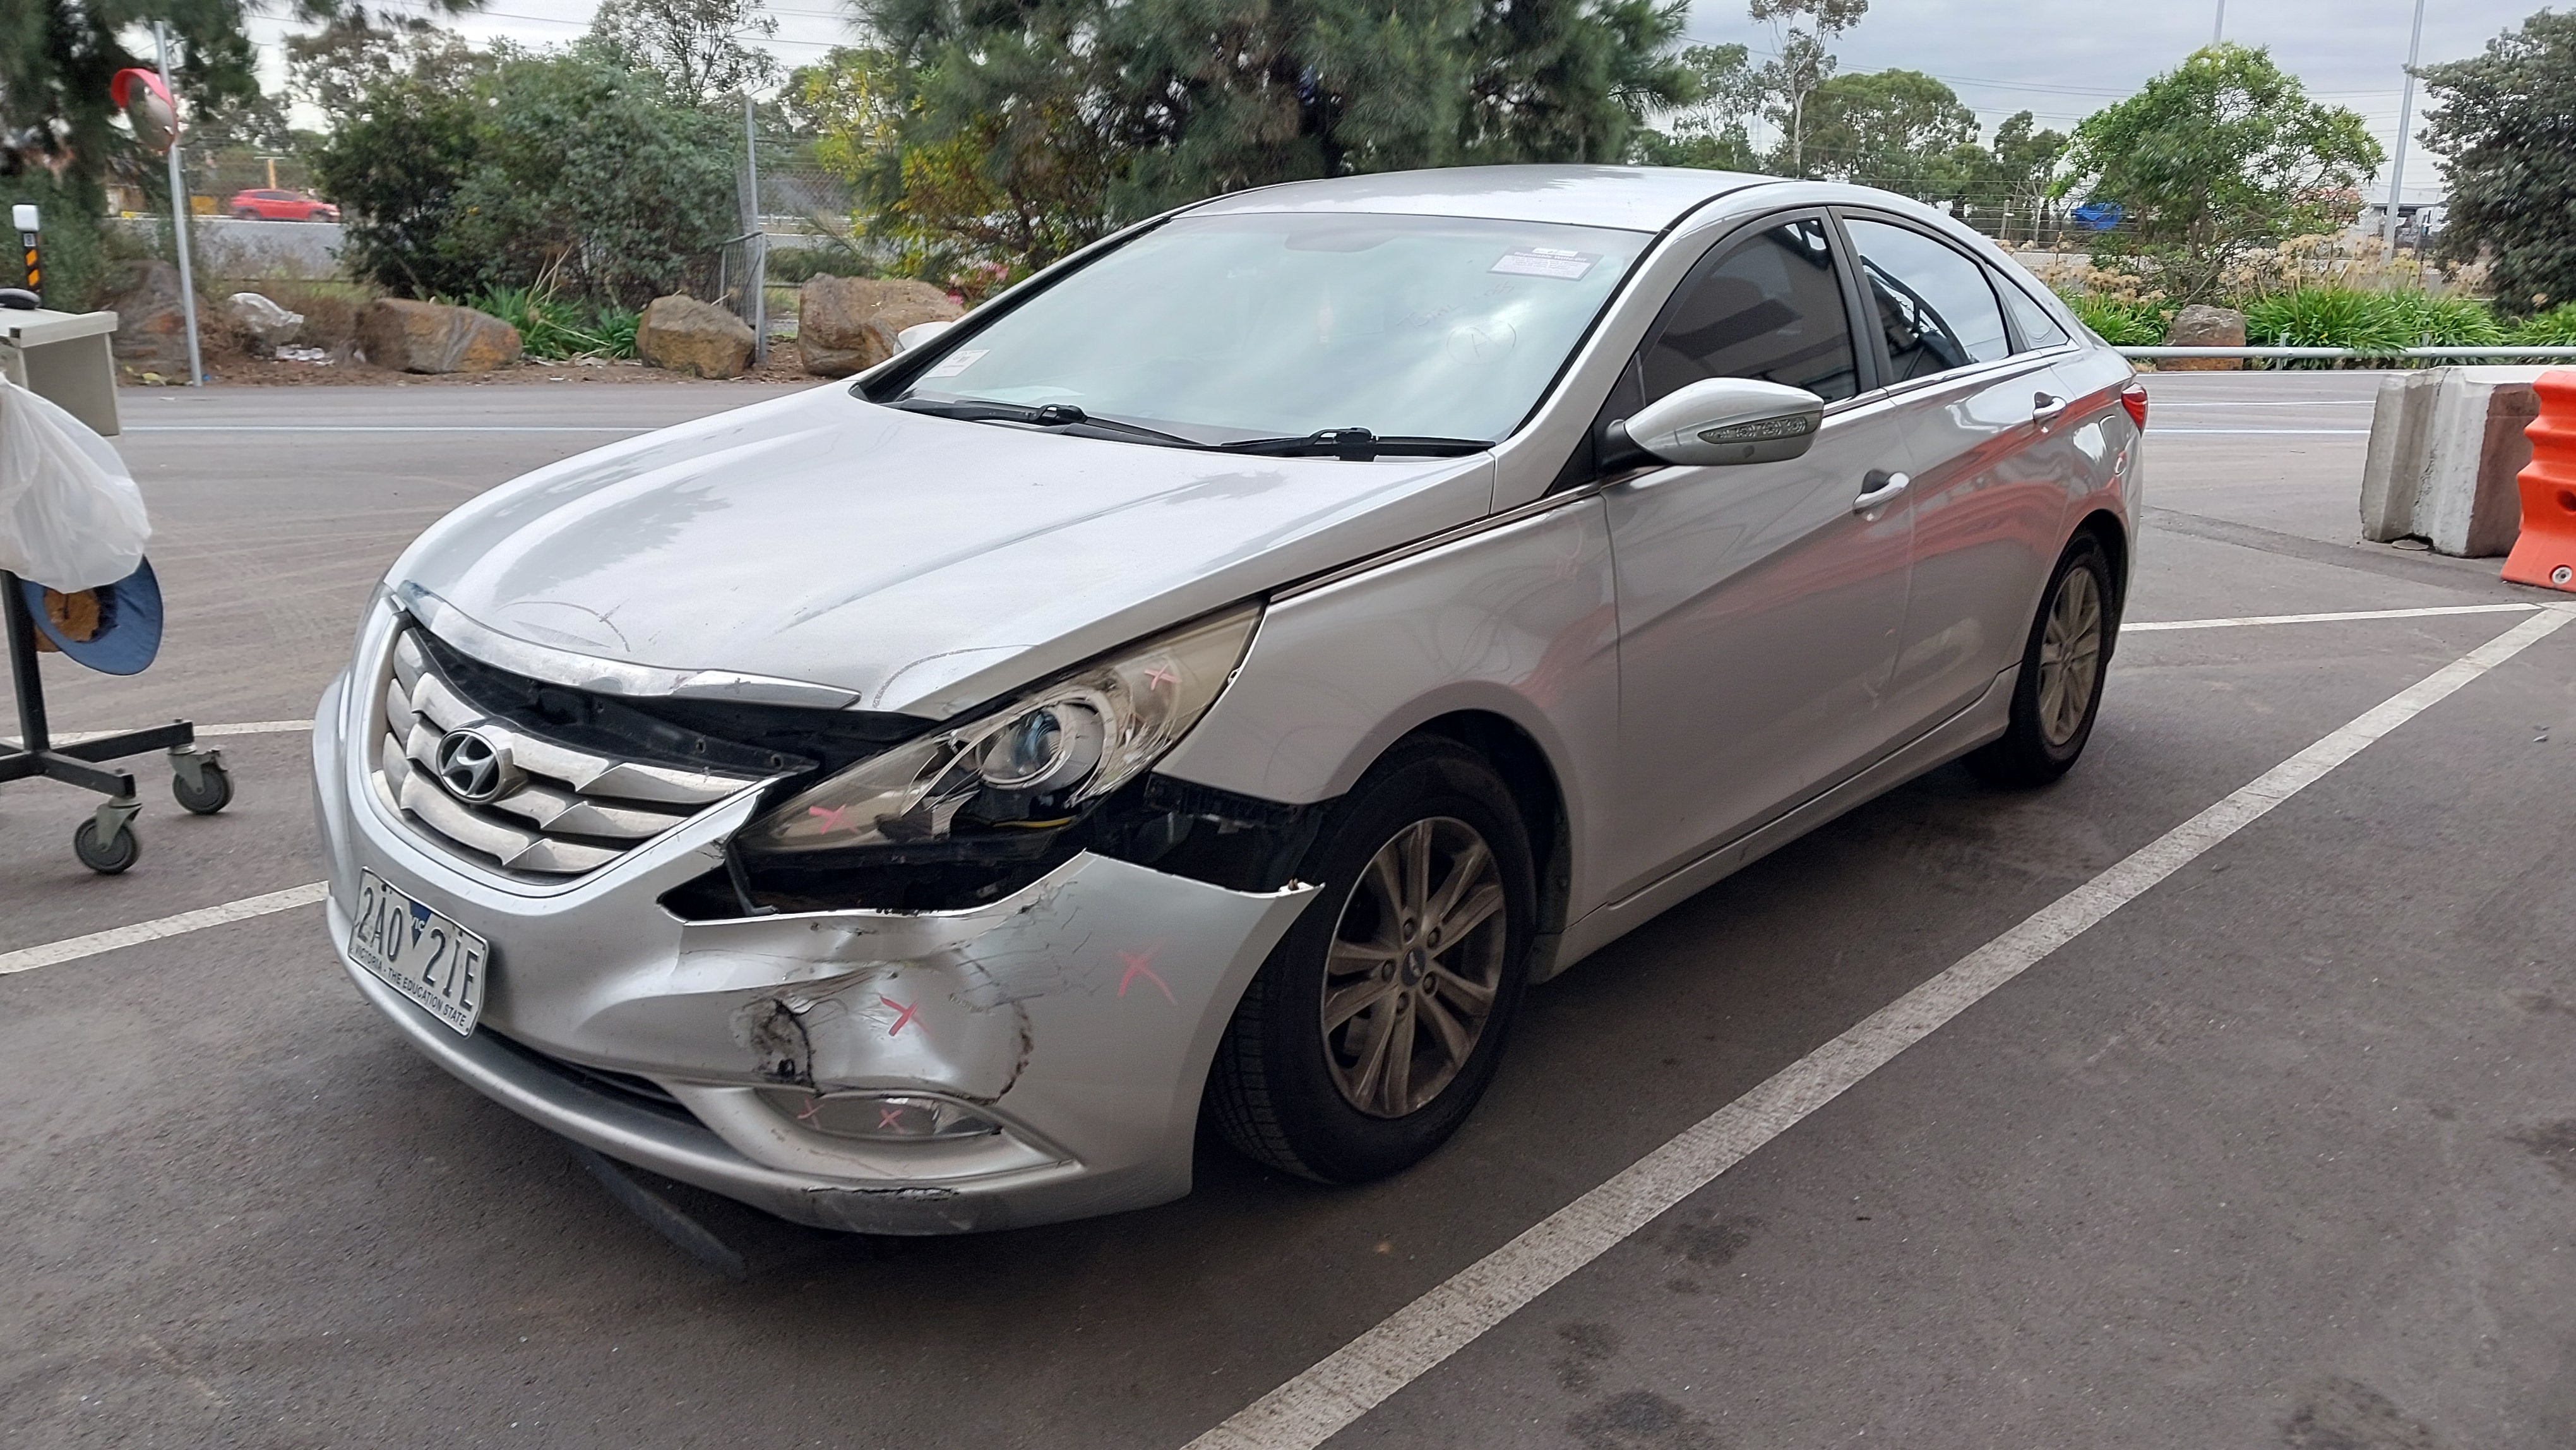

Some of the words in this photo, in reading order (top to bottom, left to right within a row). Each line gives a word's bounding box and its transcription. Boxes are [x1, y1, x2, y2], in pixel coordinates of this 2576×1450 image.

[355, 944, 382, 970] VICTORIA
[388, 968, 402, 985] THE
[403, 979, 444, 1012] EDUCATION
[443, 1004, 467, 1027] STATE
